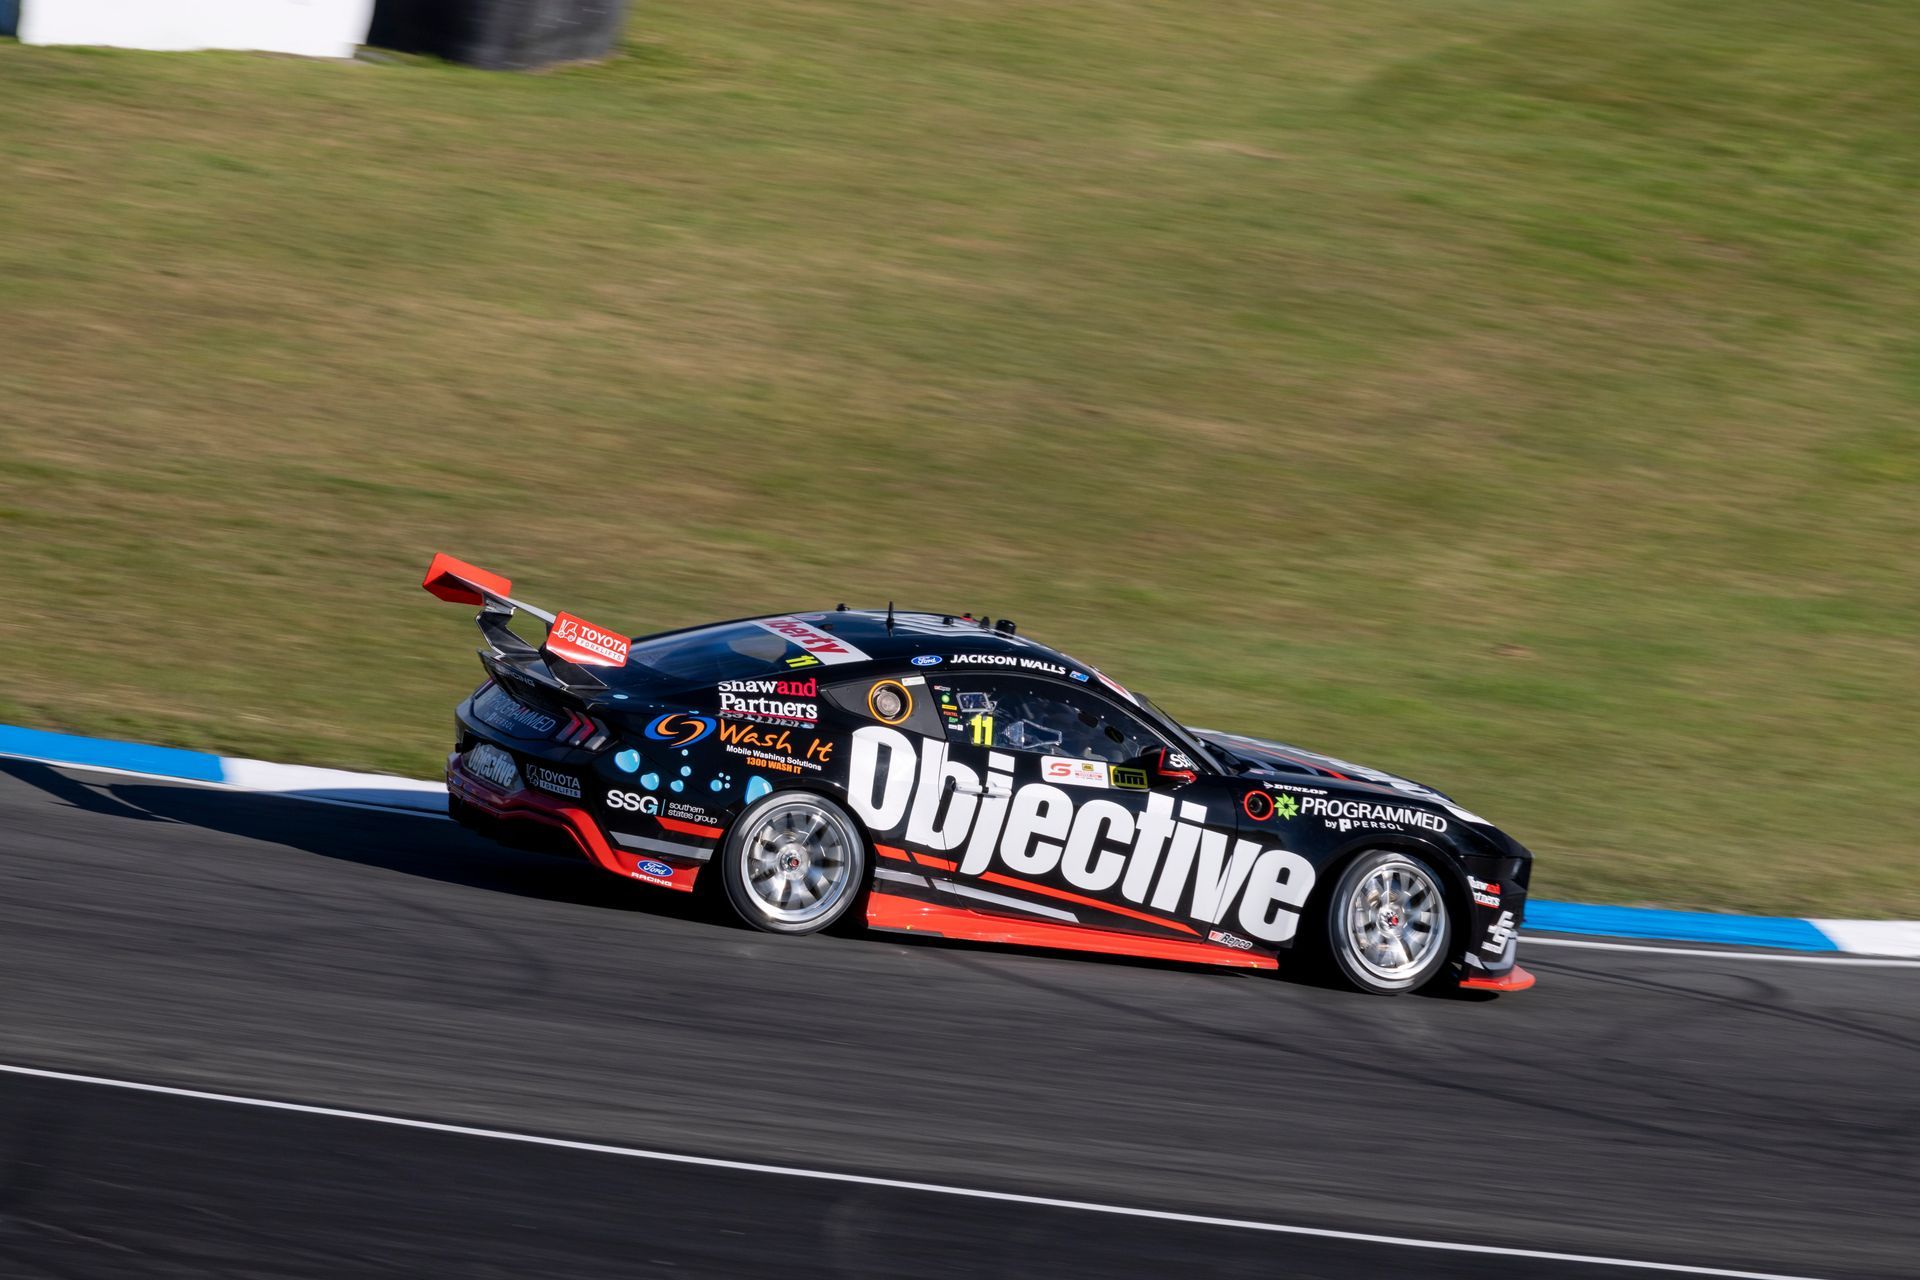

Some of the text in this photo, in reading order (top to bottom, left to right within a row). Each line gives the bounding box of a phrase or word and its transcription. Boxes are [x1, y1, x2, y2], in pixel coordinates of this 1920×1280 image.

[581, 626, 627, 654] TOYOTA
[950, 654, 1066, 675] JACKSON WALLS
[719, 692, 818, 719] Partners
[720, 719, 792, 754] Wash
[807, 738, 833, 762] It
[970, 714, 993, 746] 11
[726, 745, 822, 771] Mobile Washing Solutions
[746, 757, 802, 774] 1300 WASH IT
[539, 768, 580, 789] TOYOTA
[1274, 784, 1328, 795] DUNLOP
[606, 790, 659, 815] SSG
[669, 802, 705, 814] southern
[668, 809, 718, 824] states group
[1301, 797, 1448, 833] PROGRAMMED
[1325, 819, 1404, 831] by PERSOL
[849, 726, 1316, 942] Objective
[642, 861, 668, 876] Ford
[631, 872, 673, 887] RACING
[1221, 934, 1252, 949] Repco
